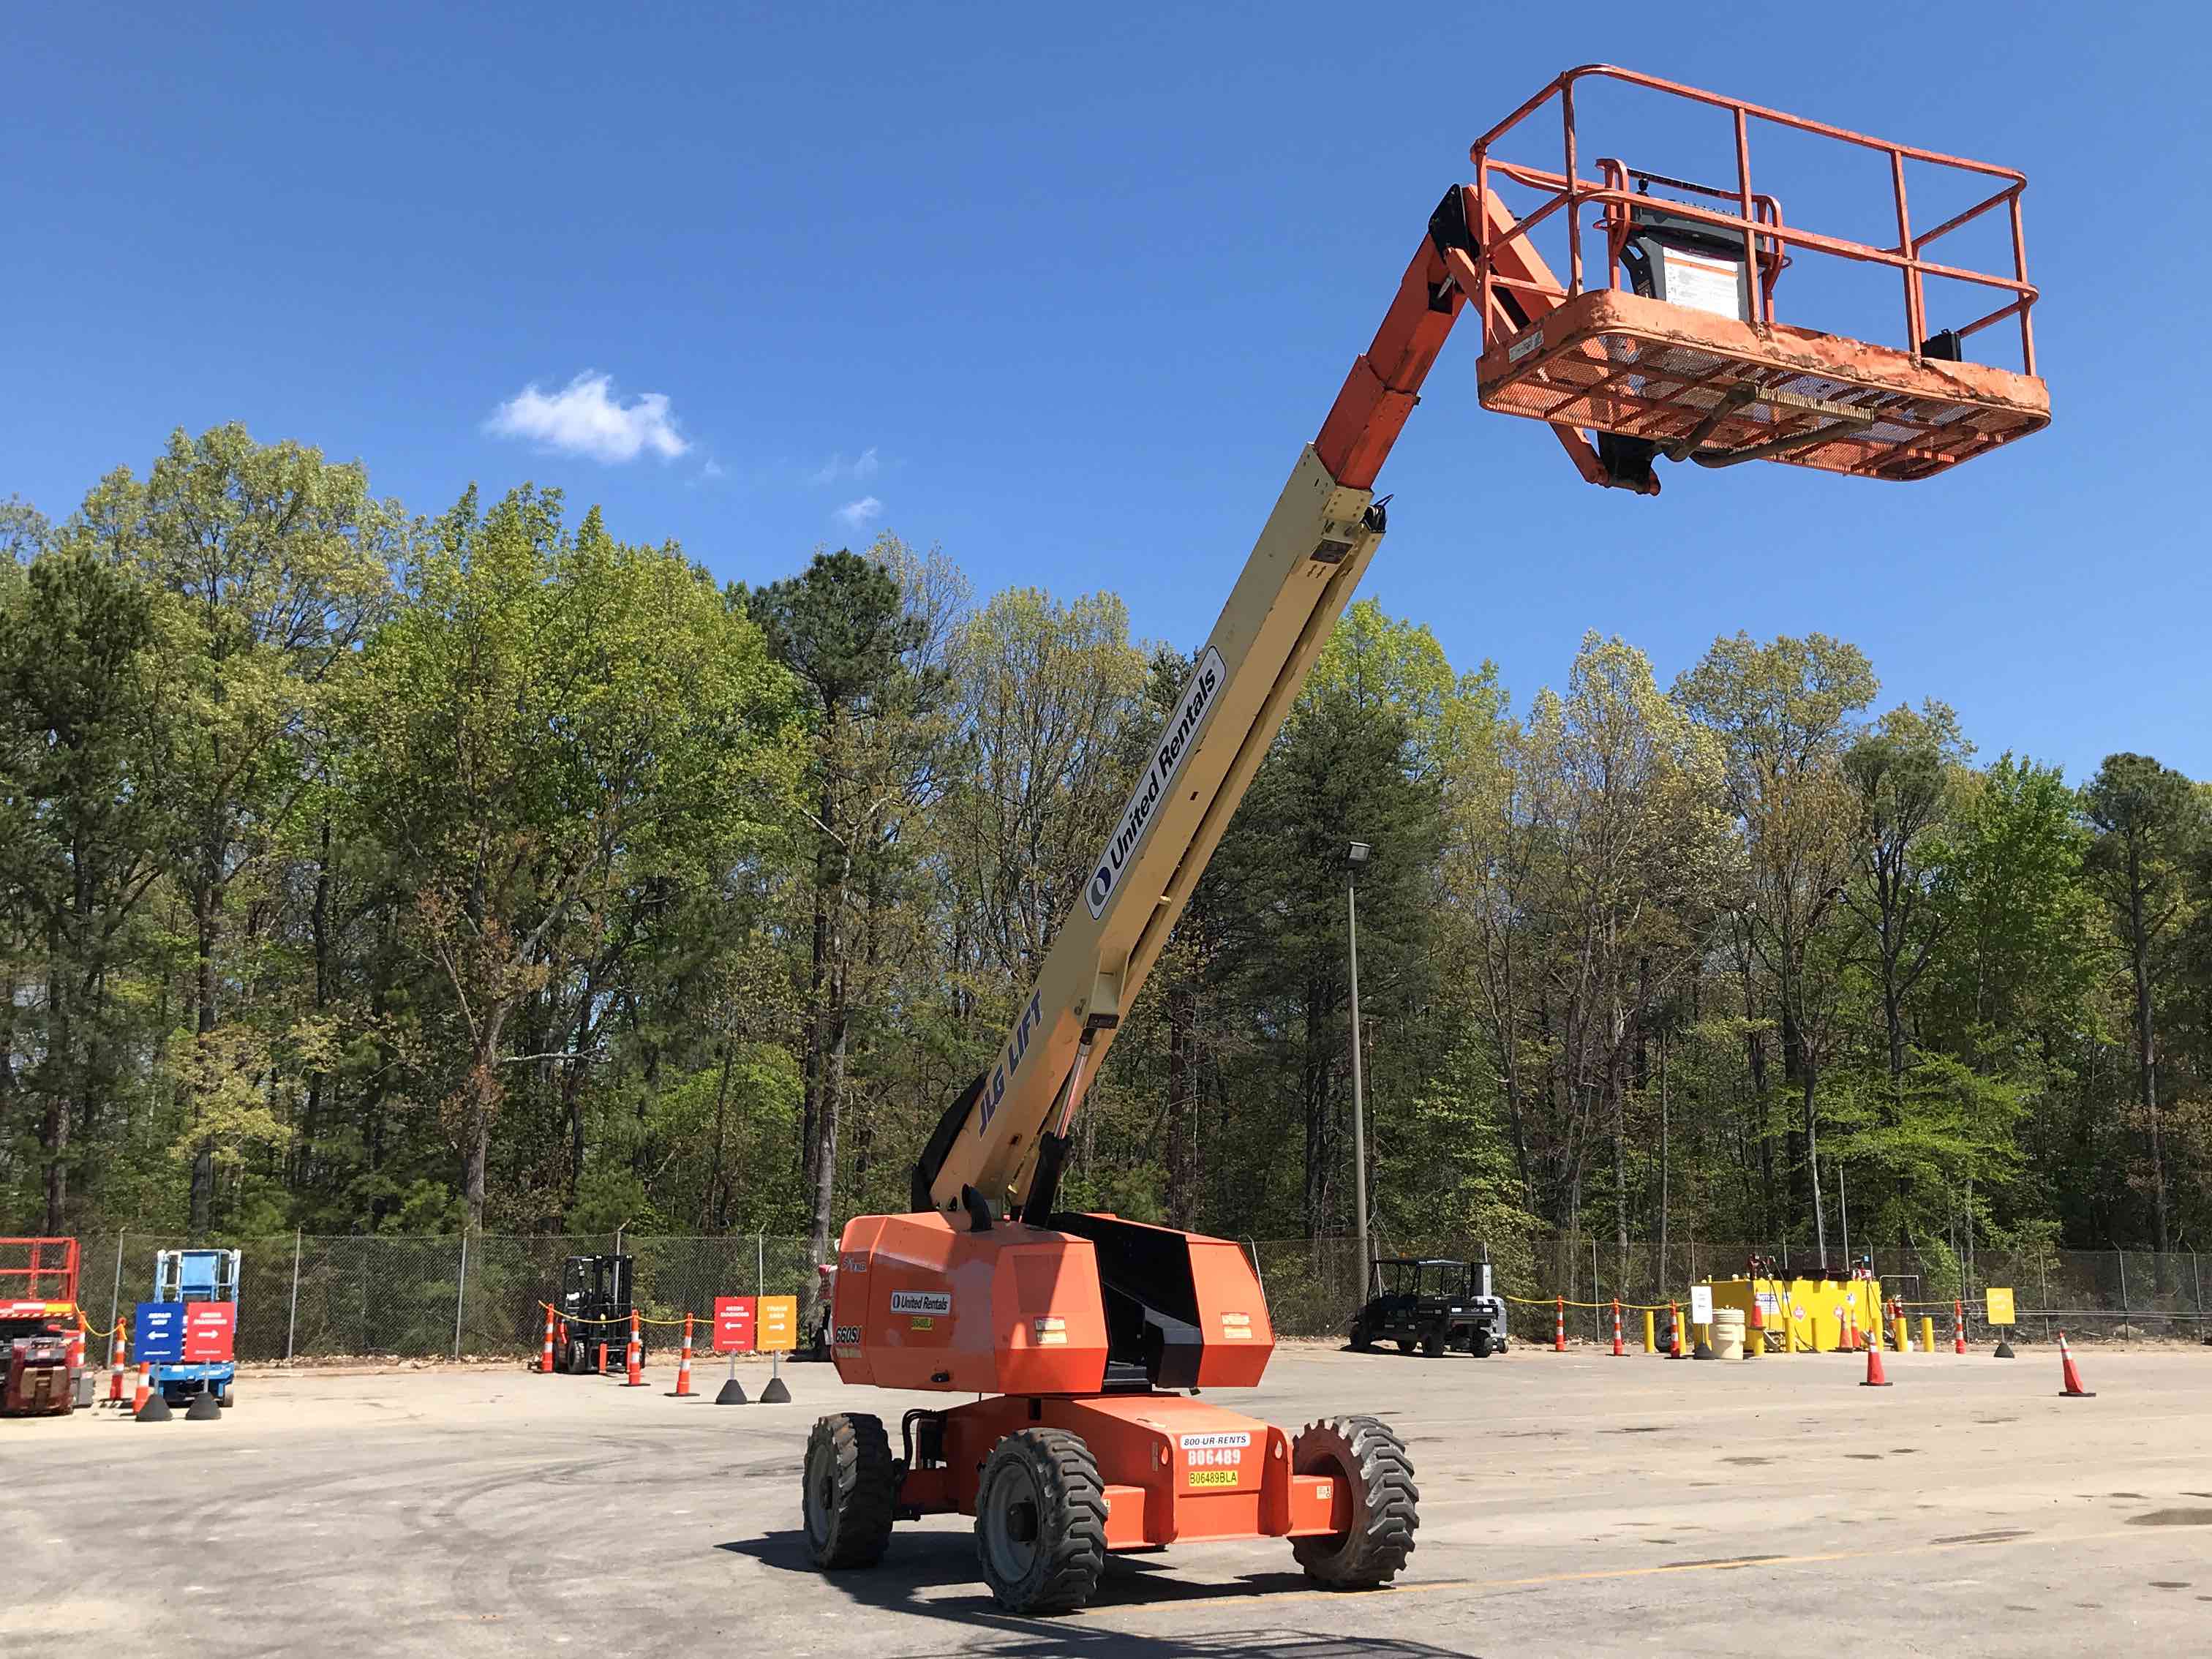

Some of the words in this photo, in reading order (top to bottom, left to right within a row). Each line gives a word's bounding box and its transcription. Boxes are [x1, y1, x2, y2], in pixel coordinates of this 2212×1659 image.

[1110, 770, 1159, 870] United
[1158, 668, 1216, 779] Rentals
[979, 1063, 1007, 1140] JLG
[1007, 988, 1042, 1078] LIFT
[901, 1295, 922, 1309] United
[922, 1296, 949, 1310] Rentals
[1187, 1449, 1241, 1466] B06489
[1189, 1472, 1237, 1484] B06489BLA
